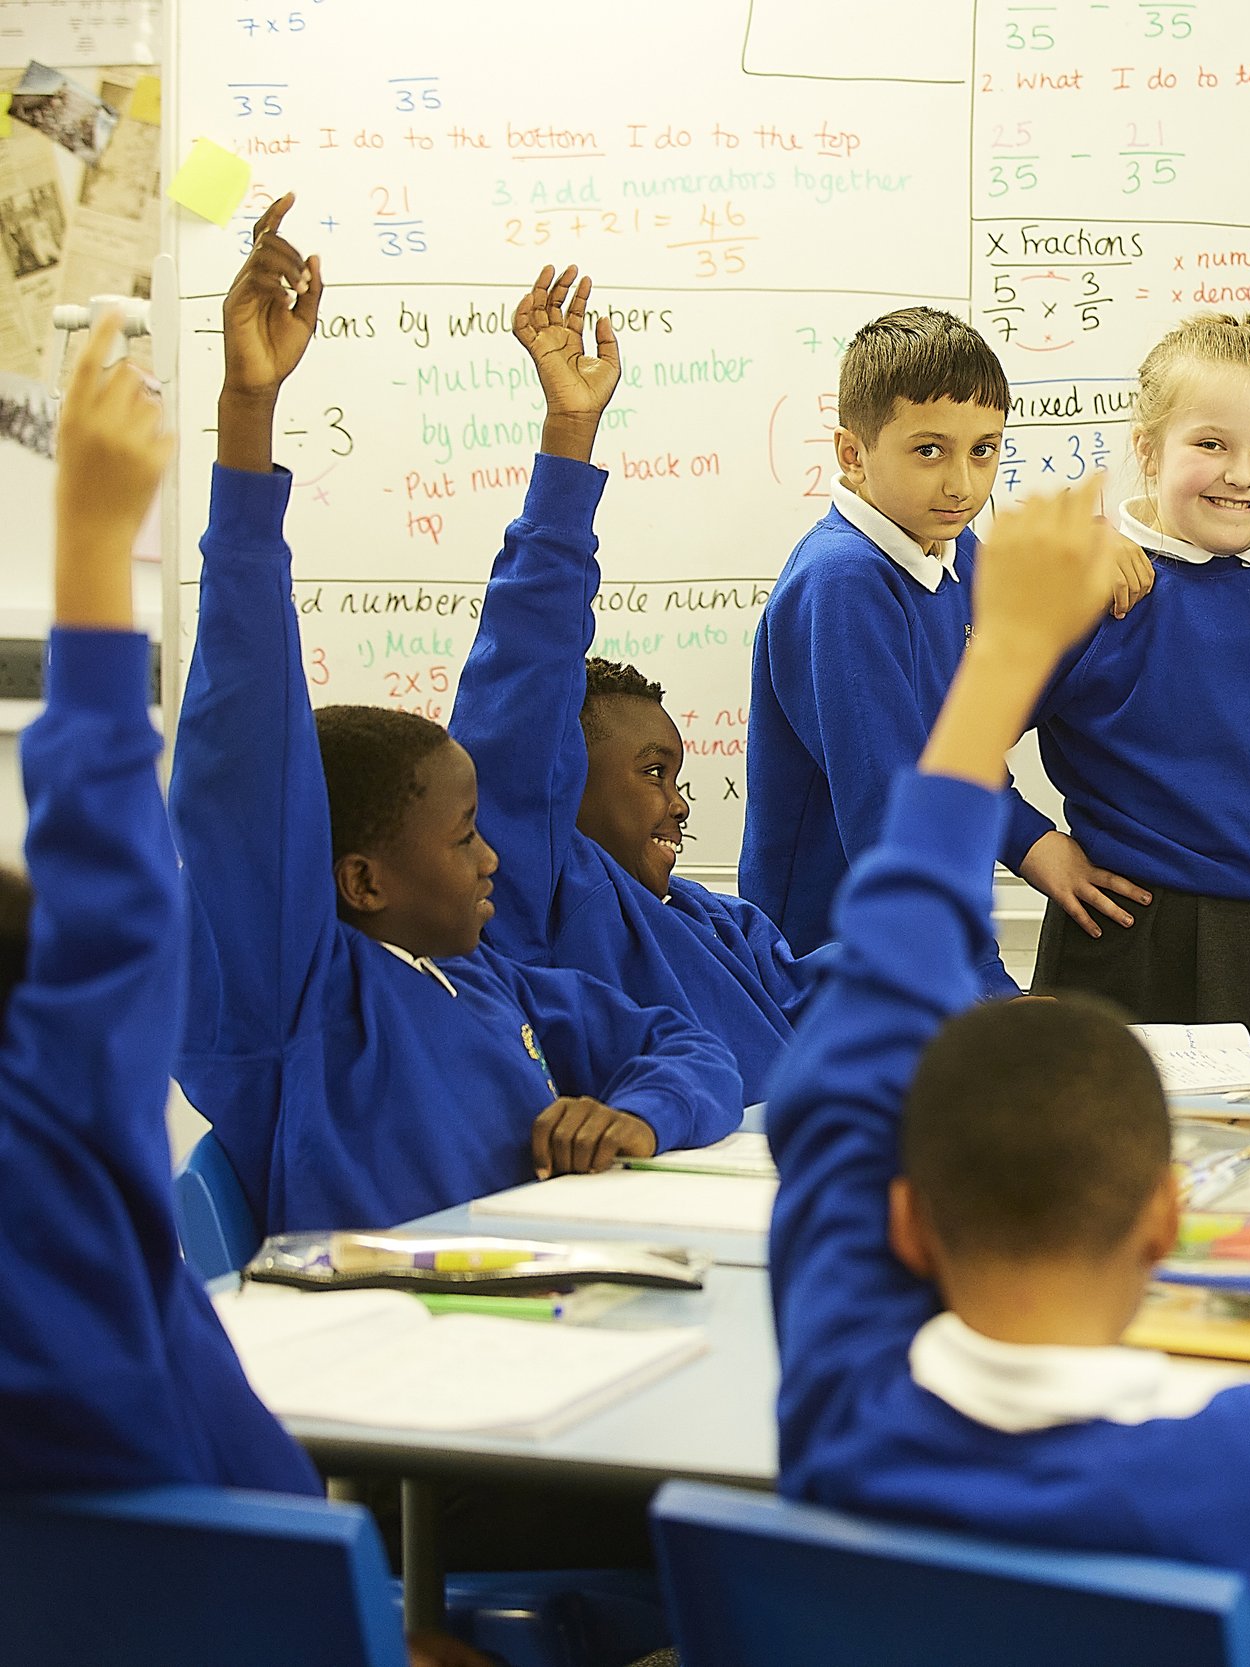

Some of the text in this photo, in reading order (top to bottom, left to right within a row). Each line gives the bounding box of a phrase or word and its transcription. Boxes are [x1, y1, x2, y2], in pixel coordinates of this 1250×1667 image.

[1005, 23, 1056, 50] 35
[1144, 12, 1193, 39] 35
[1112, 68, 1135, 90] I
[1148, 67, 1177, 89] do
[1197, 66, 1218, 88] to
[233, 95, 284, 117] 35
[395, 89, 442, 112] 35
[319, 127, 340, 149] I
[354, 127, 385, 149] do
[403, 127, 434, 150] to
[447, 126, 491, 149] the
[507, 121, 600, 150] bottom
[626, 124, 648, 148] I
[655, 124, 692, 150] do
[711, 122, 740, 149] to
[752, 120, 803, 150] the
[813, 121, 861, 157] top
[622, 165, 777, 199] numerators
[793, 164, 913, 204] together
[988, 163, 1039, 198] 35
[1121, 158, 1177, 195] 35
[370, 186, 411, 216] 21
[378, 230, 429, 257] 35
[505, 218, 552, 247] 25
[601, 211, 642, 234] 21
[1020, 225, 1144, 257] Fractions
[695, 246, 746, 278] 35
[994, 273, 1017, 303] 5
[399, 300, 430, 349] by
[449, 302, 516, 338] whol
[655, 348, 752, 387] number
[423, 412, 453, 465] by
[406, 471, 456, 500] Put
[622, 452, 680, 481] back
[691, 452, 720, 478] on
[408, 511, 444, 545] top
[341, 587, 482, 619] numbers
[385, 627, 455, 659] Make
